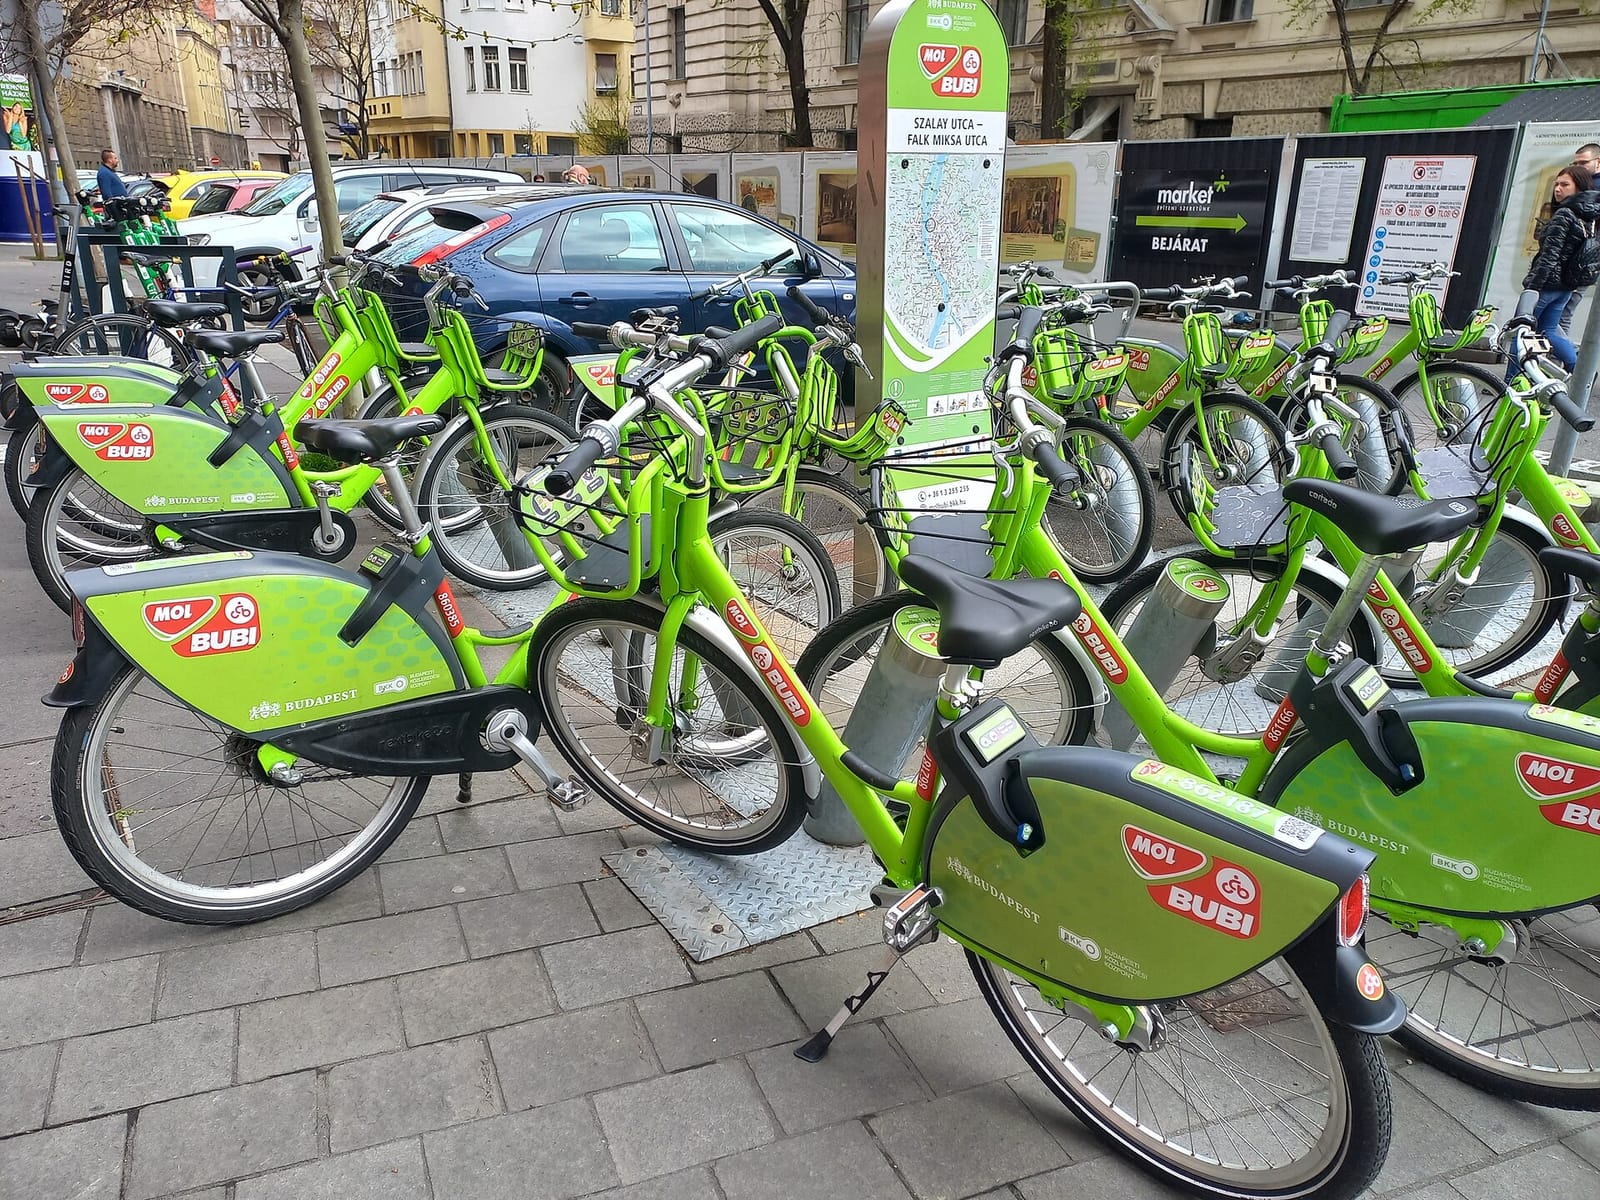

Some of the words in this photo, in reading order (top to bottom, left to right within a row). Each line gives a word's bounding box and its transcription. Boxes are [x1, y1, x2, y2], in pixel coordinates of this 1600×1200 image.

[943, 0, 977, 10] BUDAPEST
[923, 49, 945, 62] MOL
[941, 76, 978, 94] BUBI
[914, 117, 948, 130] SZALAY
[951, 118, 974, 130] UTCA
[907, 134, 930, 146] FALK
[932, 134, 962, 146] MIKSA
[965, 135, 988, 146] UTCA
[1157, 180, 1214, 204] market
[1151, 233, 1209, 252] BEJÁRAT
[63, 260, 73, 286] BIRD
[321, 355, 339, 376] BUBI
[50, 386, 72, 395] MOL
[326, 378, 347, 400] BUBI
[84, 426, 110, 436] MOL
[107, 445, 152, 458] BUBI
[169, 496, 220, 505] BUDAPEST
[1555, 517, 1571, 535] MOL
[152, 603, 193, 623] MOL
[438, 592, 460, 628] 860385
[728, 605, 749, 629] MOL
[190, 626, 257, 653] BUBI
[1392, 627, 1428, 666] BUBI
[1083, 633, 1122, 677] BUBI
[1539, 663, 1564, 694] 861412
[285, 689, 358, 712] BUDAPEST
[765, 668, 806, 719] BUBI
[1267, 708, 1295, 742] 861166
[918, 753, 933, 790] 862187
[1526, 760, 1575, 784] MOL
[1327, 819, 1409, 855] BUDAPEST
[1132, 834, 1176, 865] MOL
[1437, 858, 1458, 870] BKK
[973, 876, 1040, 925] BUDAPEST
[1167, 885, 1255, 937] BUBI
